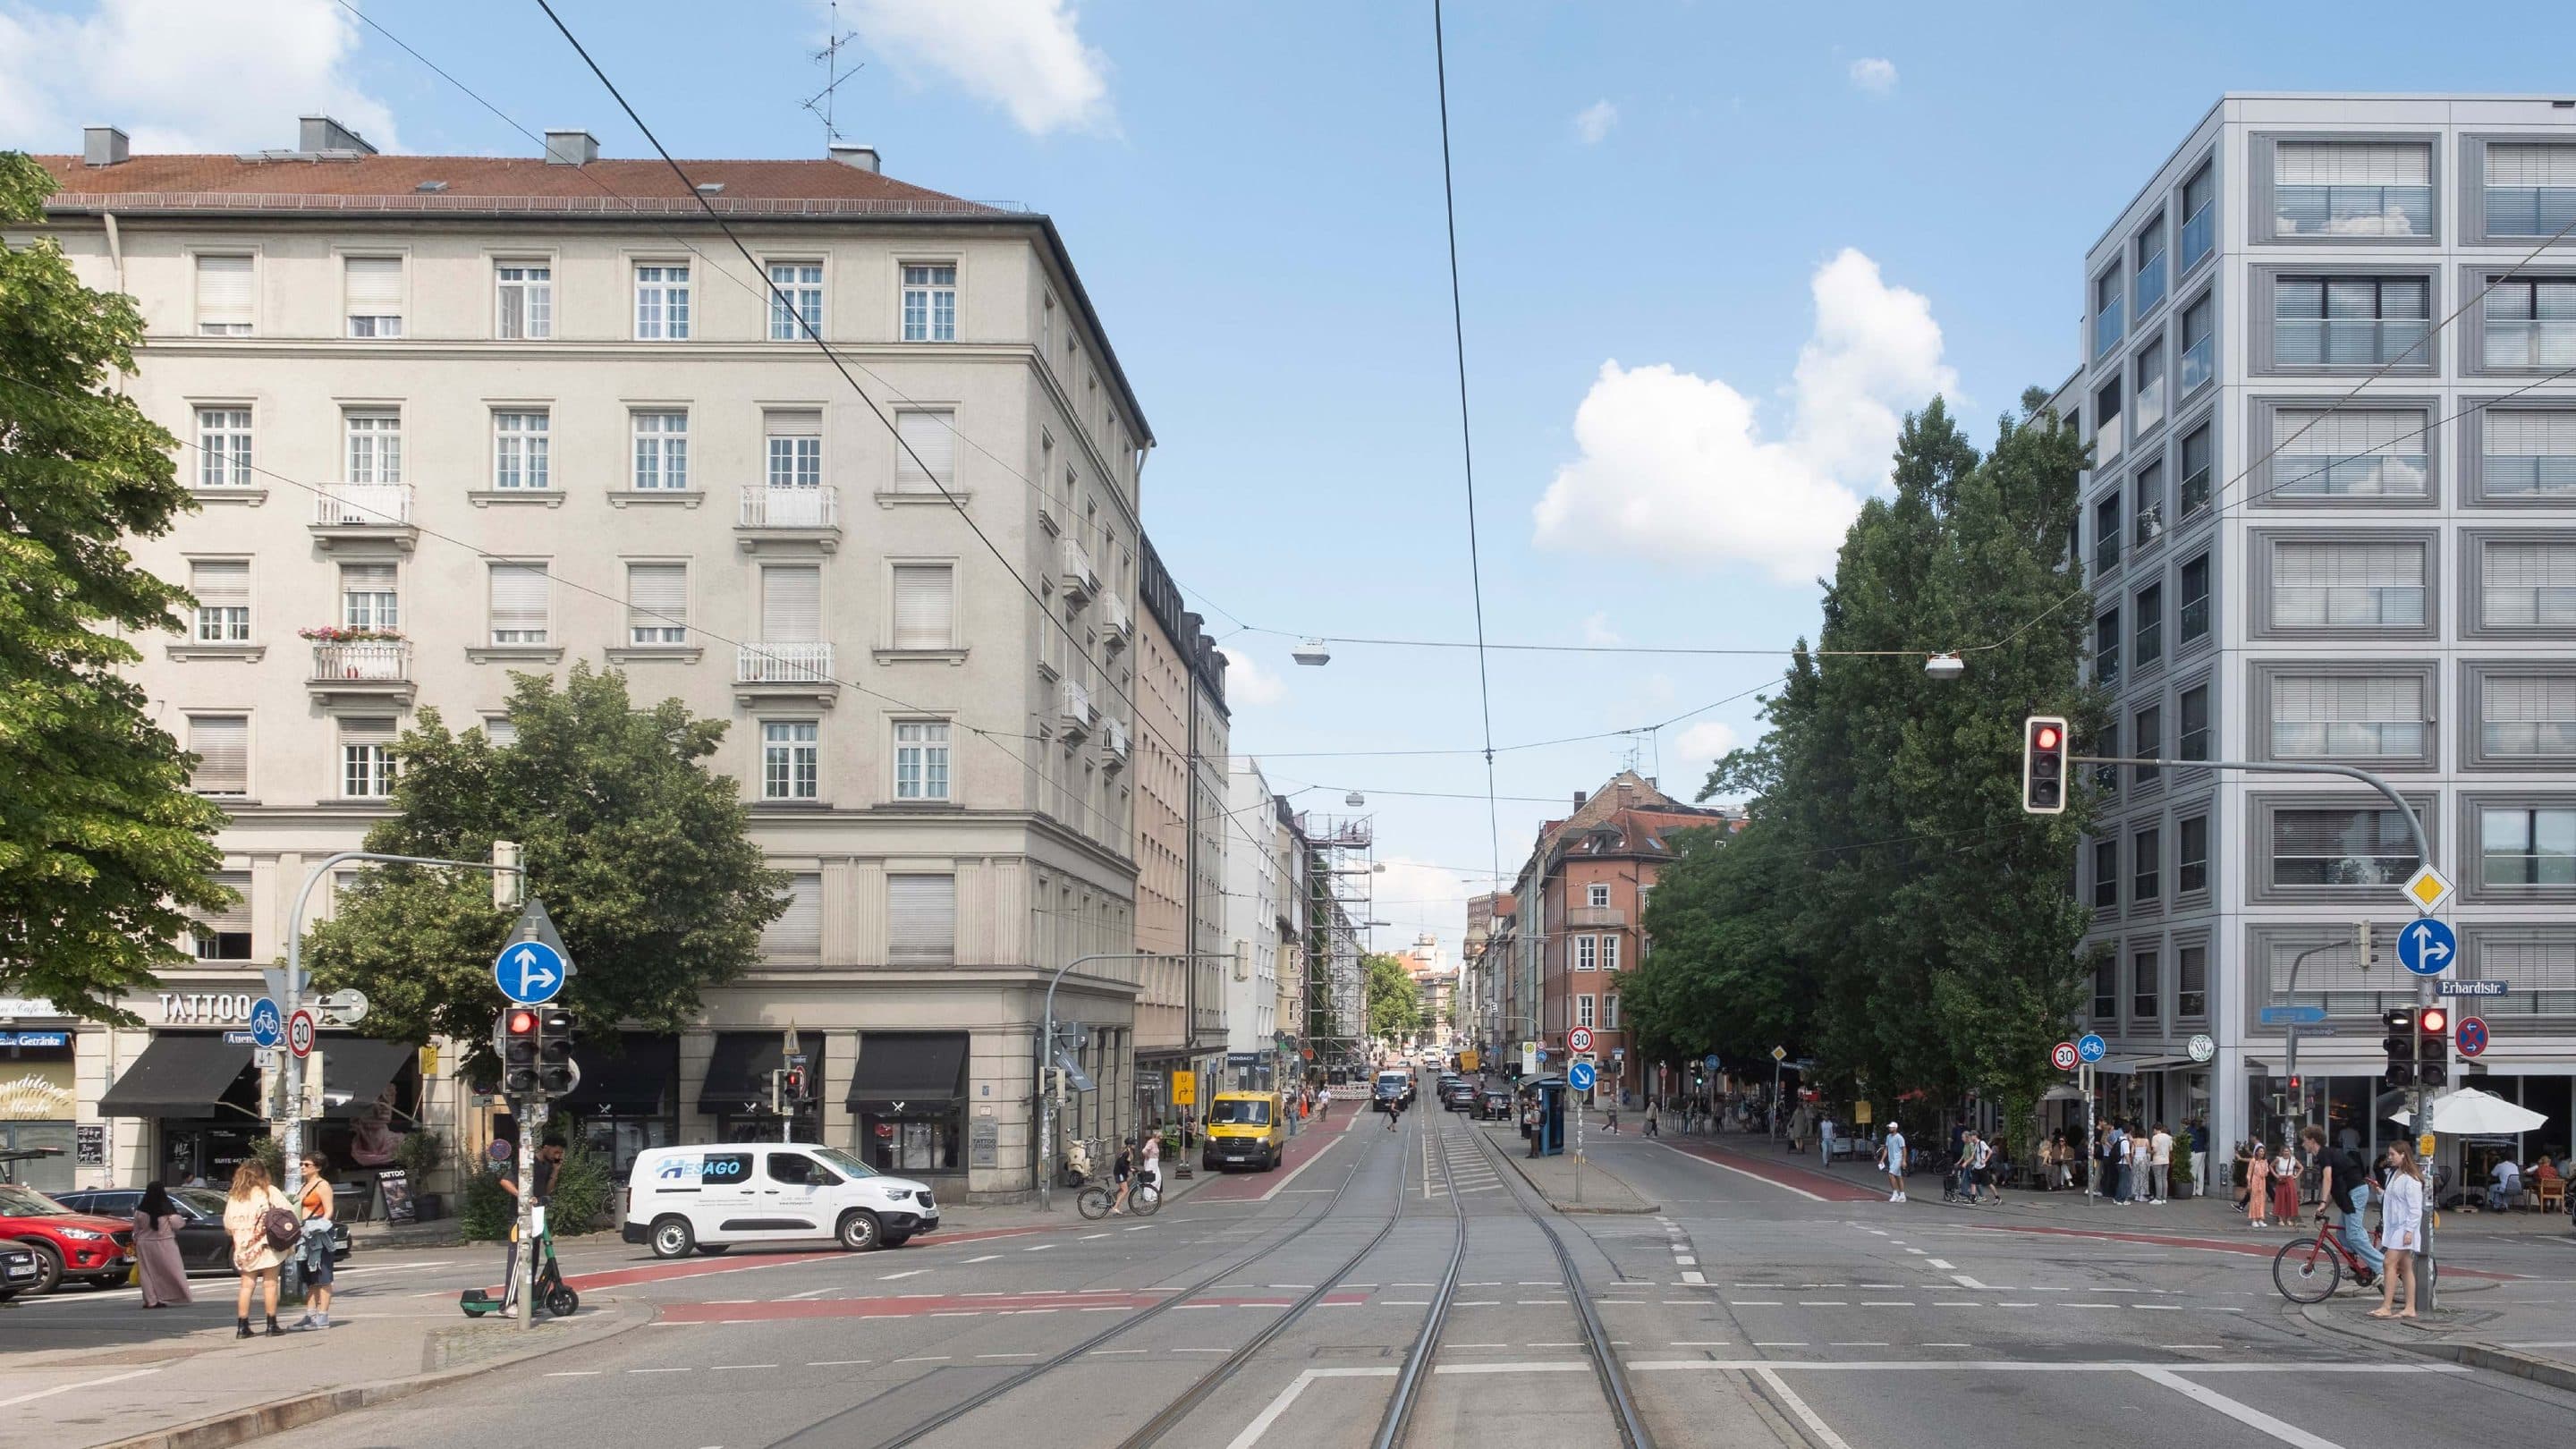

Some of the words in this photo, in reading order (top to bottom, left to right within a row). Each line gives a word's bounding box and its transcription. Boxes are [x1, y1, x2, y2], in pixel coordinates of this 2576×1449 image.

[2442, 981, 2502, 995] Erhardtstr.
[157, 993, 251, 1020] TATTOO
[293, 1023, 309, 1045] 30
[1573, 1033, 1589, 1046] 30
[19, 1036, 61, 1046] Getränke
[2058, 1050, 2073, 1063] 30
[1181, 1075, 1188, 1083] U
[379, 1170, 405, 1178] TATTOO
[656, 1159, 741, 1179] HESAGO
